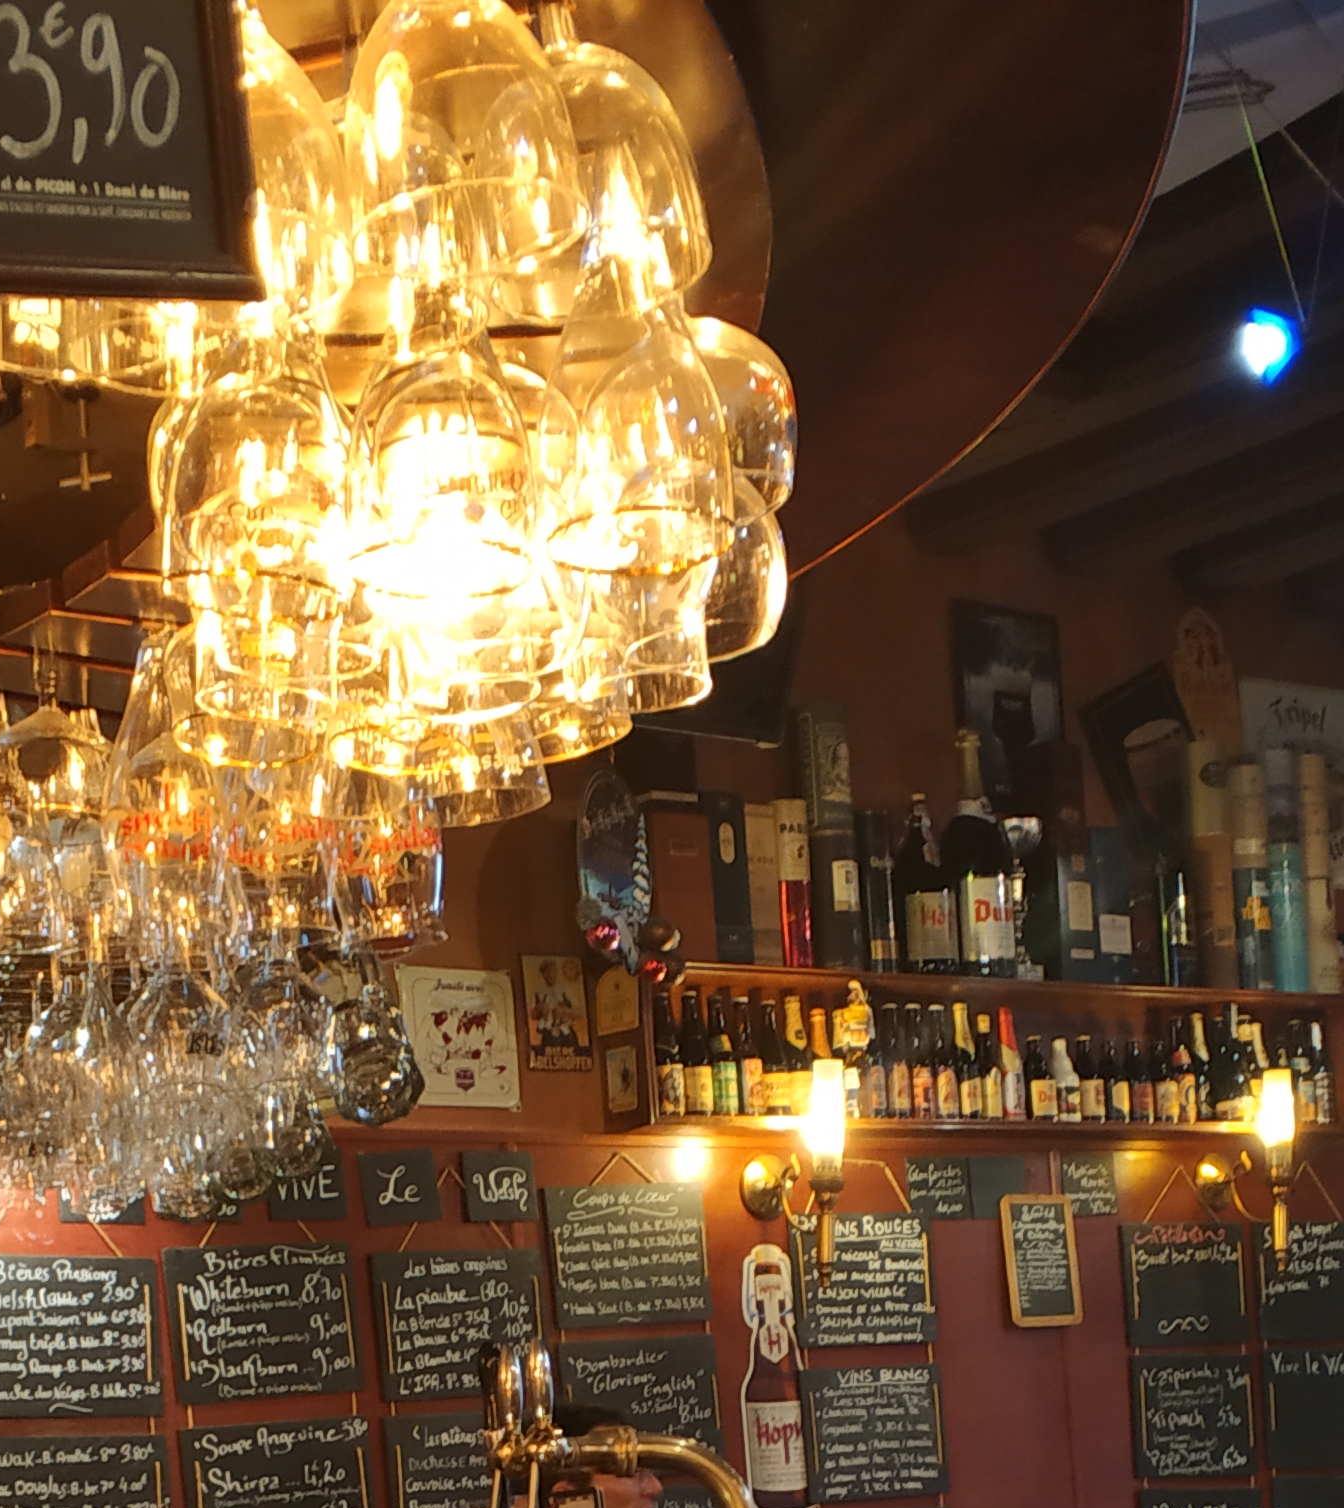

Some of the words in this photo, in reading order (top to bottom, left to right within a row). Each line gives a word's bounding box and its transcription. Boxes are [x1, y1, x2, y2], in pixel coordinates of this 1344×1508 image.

[16, 176, 31, 191] de
[35, 177, 76, 195] PICON
[105, 182, 136, 198] Demi
[140, 183, 155, 199] de
[278, 1165, 340, 1201] VIVE
[377, 1165, 422, 1206] Le
[473, 1166, 529, 1211] Welsh
[618, 1191, 631, 1204] de
[53, 1259, 118, 1285] Pressions
[203, 1249, 268, 1278] Bières
[395, 1285, 415, 1311] La
[393, 1314, 409, 1332] La
[396, 1335, 411, 1352] La
[397, 1355, 413, 1373] La
[1271, 1352, 1299, 1375] Vive
[1305, 1352, 1320, 1375] le
[837, 1369, 873, 1384] VINS
[880, 1368, 930, 1382] BLANCS
